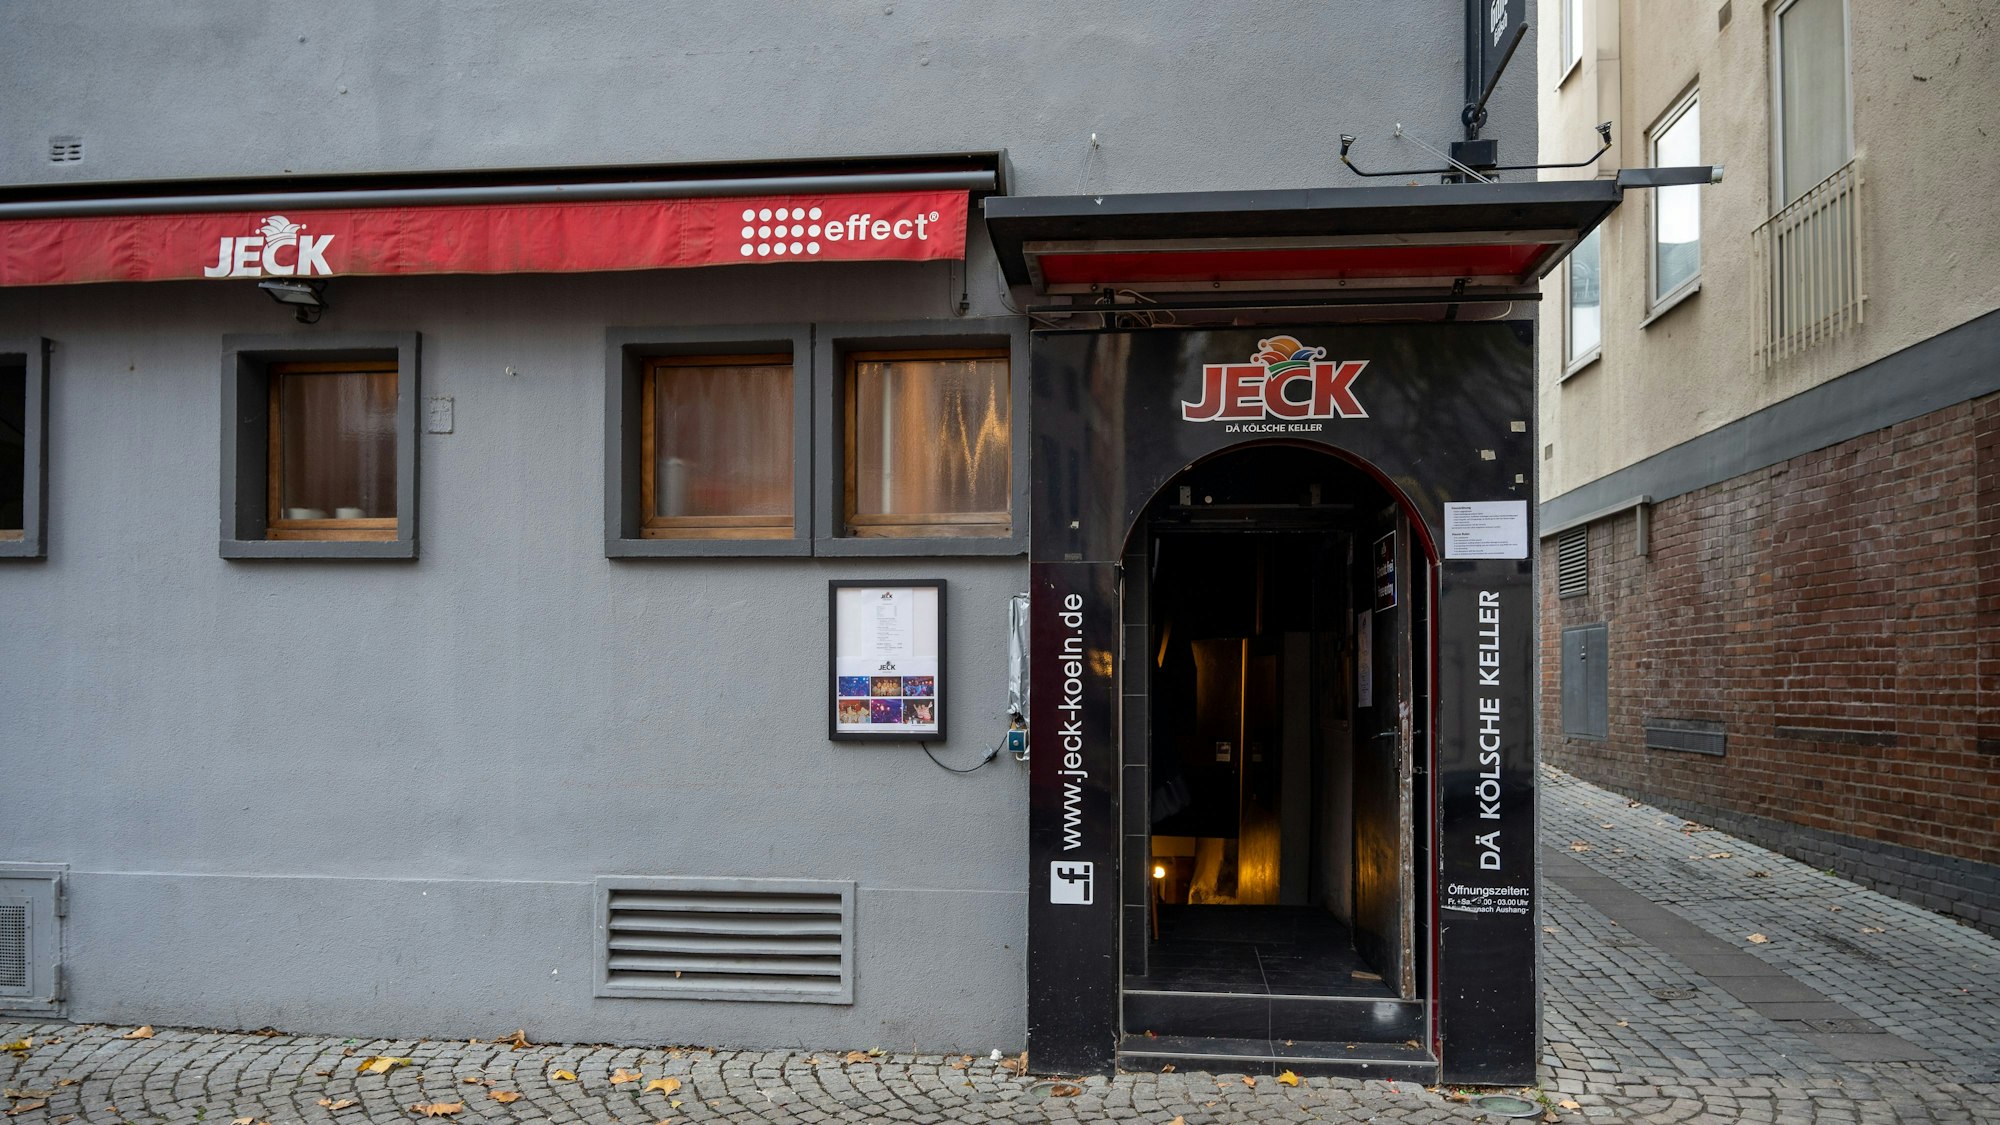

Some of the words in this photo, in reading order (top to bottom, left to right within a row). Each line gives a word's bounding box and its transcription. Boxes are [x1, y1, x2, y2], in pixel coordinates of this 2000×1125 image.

[204, 234, 335, 277] JECK
[1181, 360, 1370, 422] JECK
[1225, 423, 1240, 433] DÄ
[1242, 422, 1286, 433] KÖLSCHE
[1288, 423, 1323, 432] KELLER
[1478, 590, 1500, 686] KELLER
[1058, 593, 1088, 851] www.jeck-koeln.de
[1475, 697, 1501, 819] KÖLSCHE
[1475, 830, 1501, 871] DÄ
[1448, 884, 1529, 897] Öffnungszeiten:
